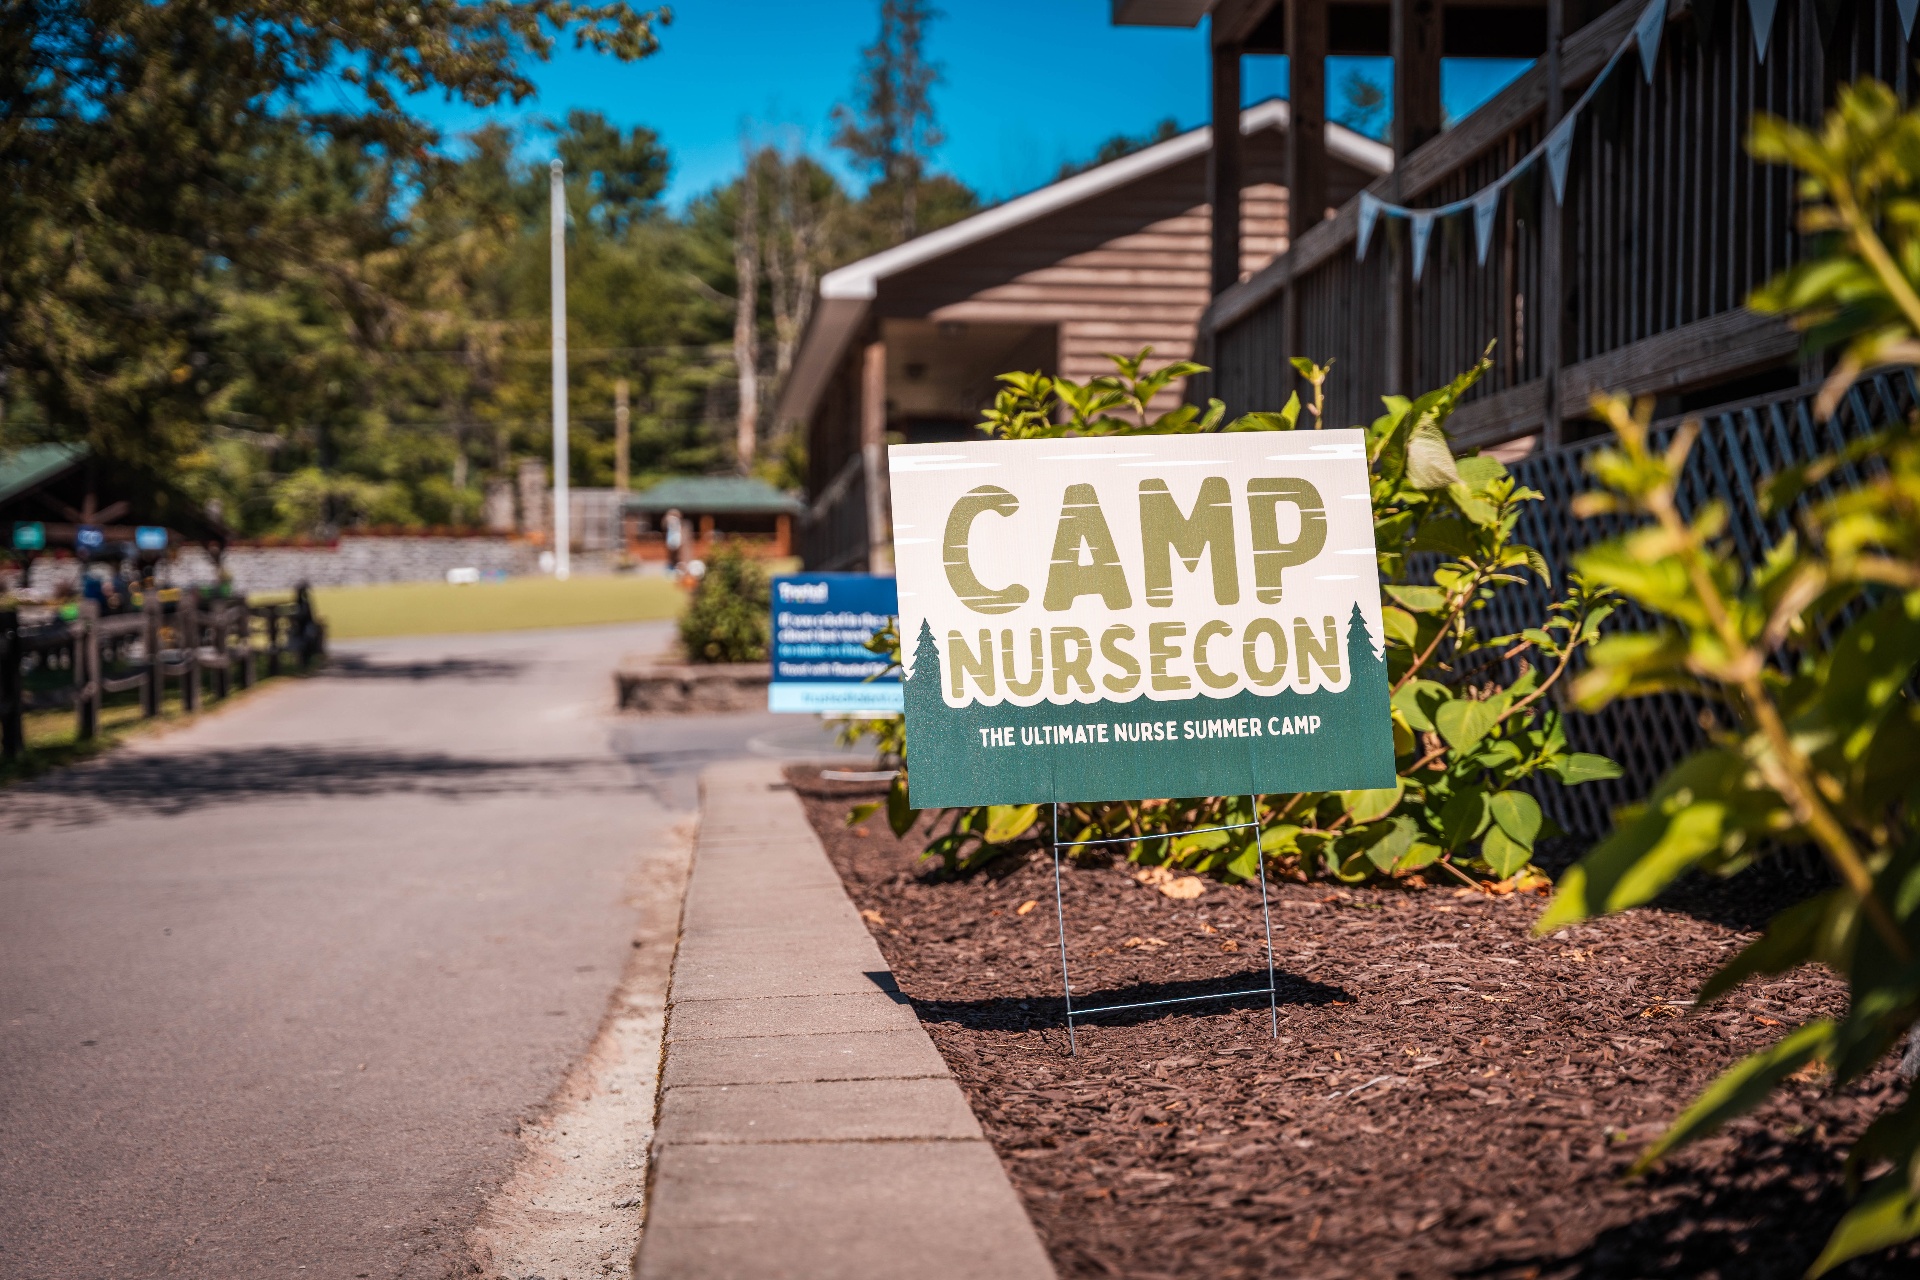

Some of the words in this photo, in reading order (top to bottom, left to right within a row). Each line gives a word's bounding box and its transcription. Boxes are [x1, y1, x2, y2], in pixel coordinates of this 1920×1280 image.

[942, 476, 1328, 615] CAMP
[946, 615, 1342, 699] NURSECON
[979, 726, 1016, 748] THE
[1020, 723, 1109, 747] ULTIMATE
[1113, 720, 1179, 742] NURSE
[1183, 717, 1263, 740] SUMMER
[1267, 715, 1322, 737] CAMP
